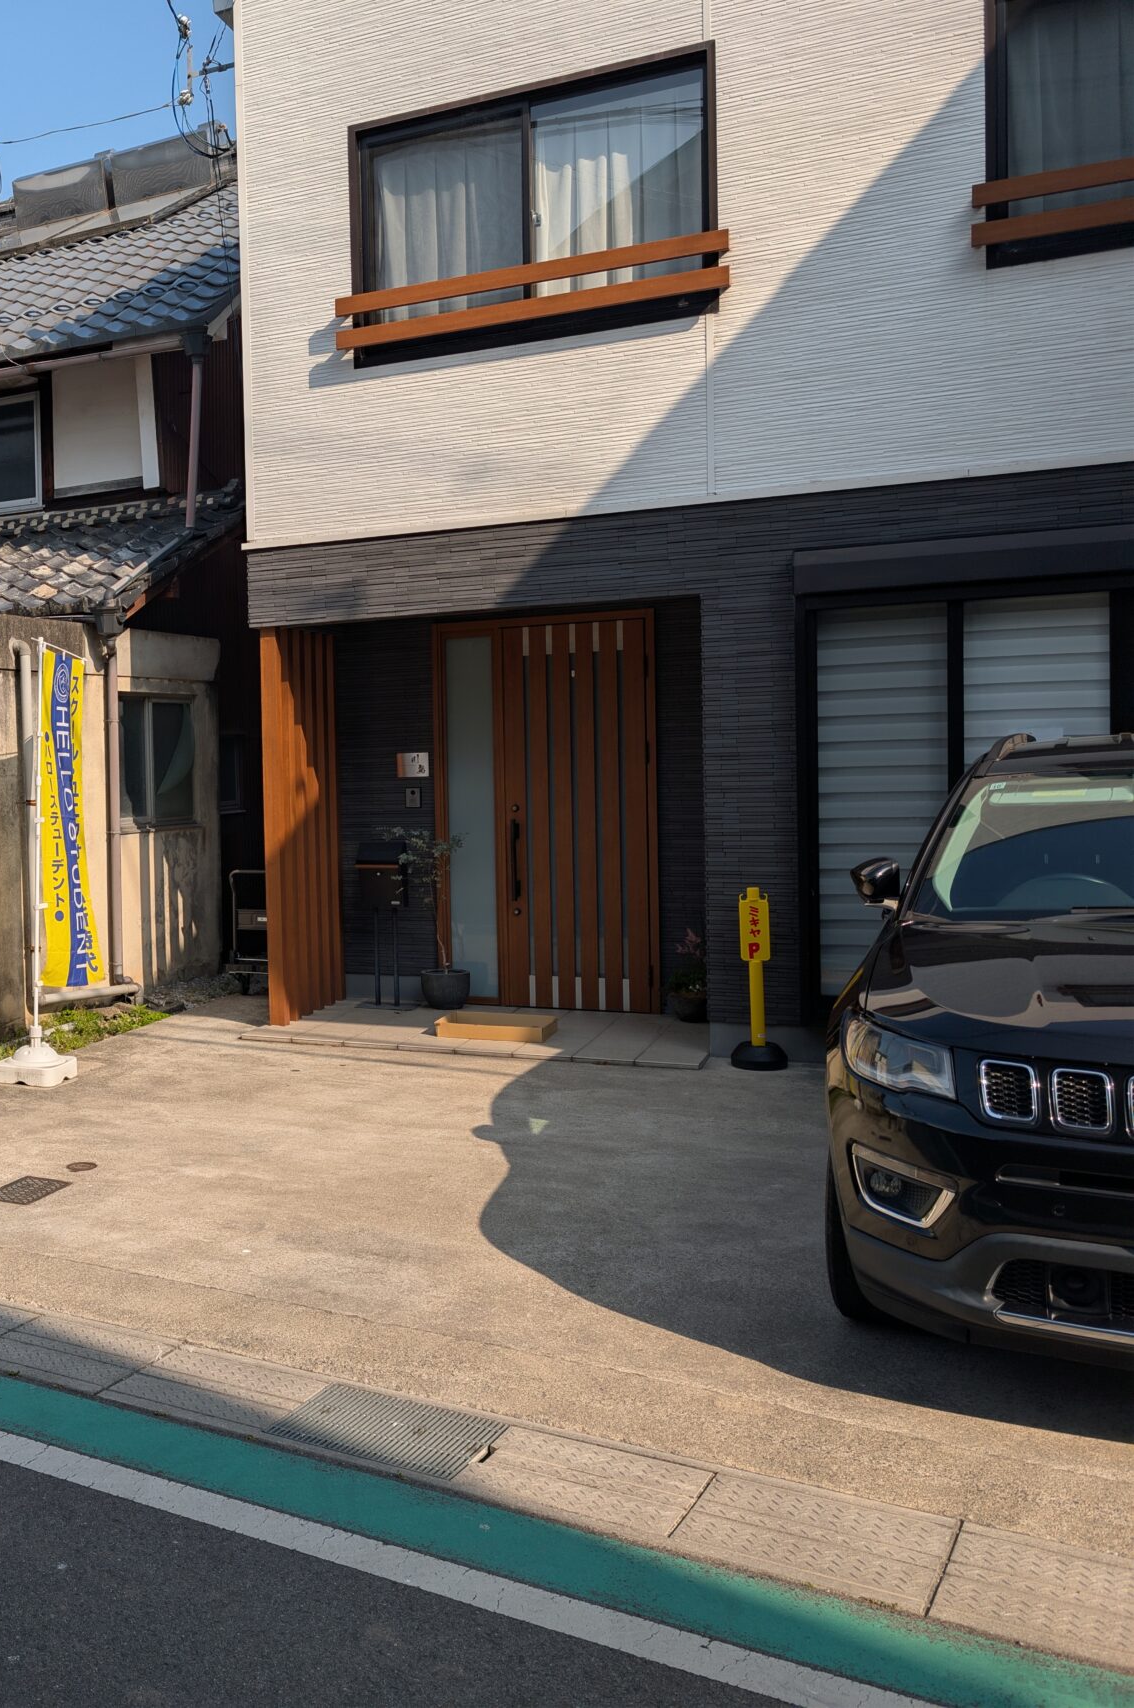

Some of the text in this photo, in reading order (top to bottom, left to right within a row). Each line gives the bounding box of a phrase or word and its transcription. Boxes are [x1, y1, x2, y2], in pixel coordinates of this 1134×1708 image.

[55, 706, 74, 812] HELLO
[45, 745, 65, 908] ハローステューデント
[748, 942, 760, 959] P
[749, 905, 761, 938] ミキヤ
